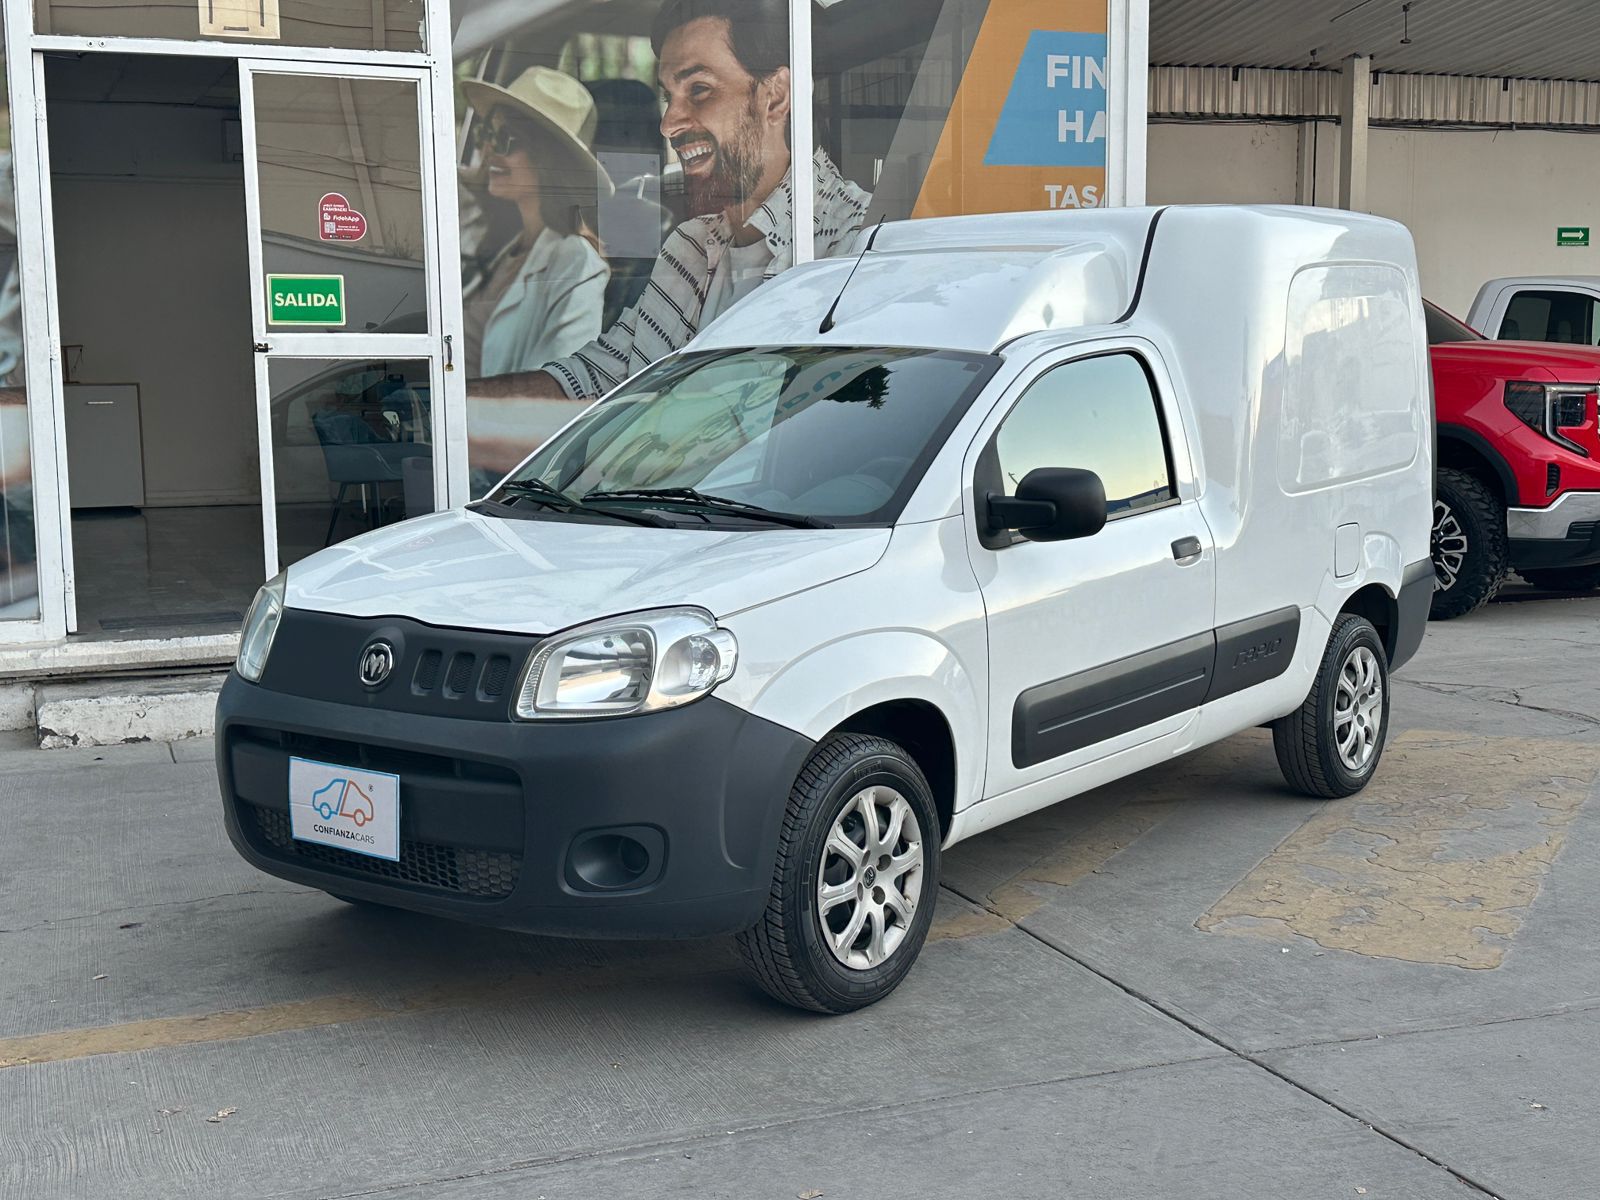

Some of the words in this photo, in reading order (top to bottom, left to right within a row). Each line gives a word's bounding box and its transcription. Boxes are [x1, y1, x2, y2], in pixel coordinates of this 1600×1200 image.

[1047, 54, 1106, 90] FIN
[1044, 184, 1105, 208] TAS
[274, 292, 339, 307] SALIDA
[313, 824, 375, 844] CONFIANZACARS
